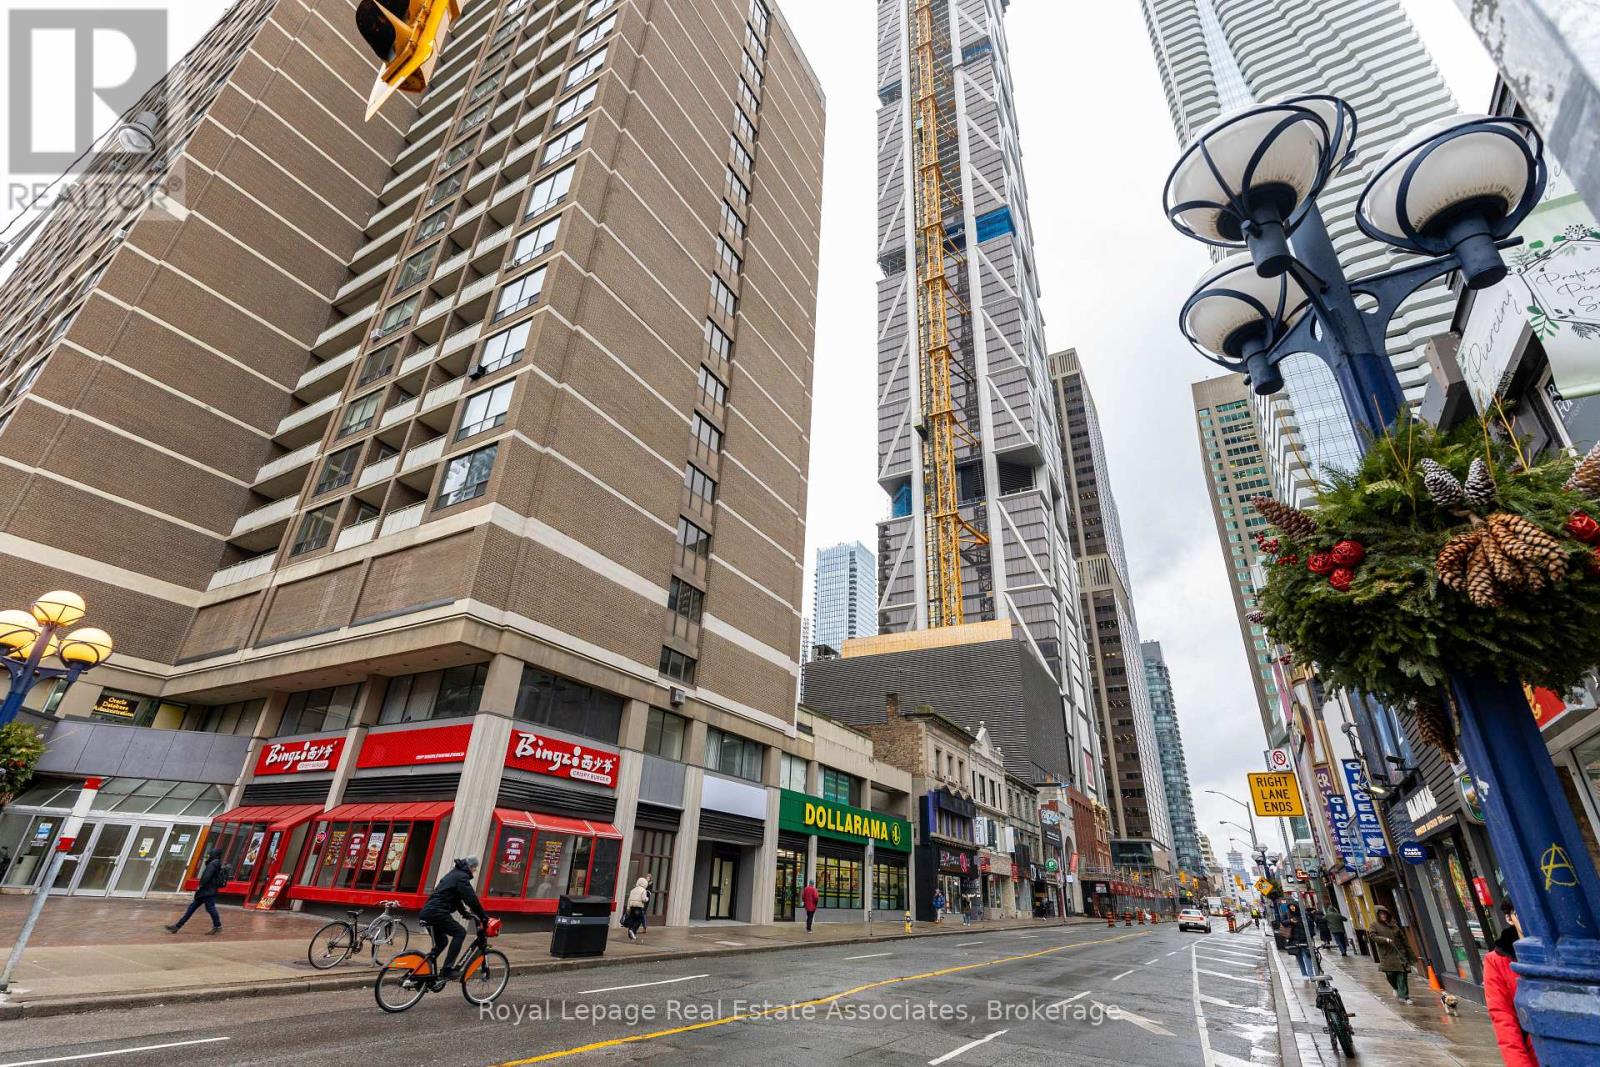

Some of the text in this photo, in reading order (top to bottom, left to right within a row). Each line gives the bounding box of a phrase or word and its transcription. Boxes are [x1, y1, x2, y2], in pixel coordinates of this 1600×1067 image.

[1468, 287, 1522, 387] Piercing
[102, 701, 129, 711] Database
[265, 741, 311, 770] Bingzi
[515, 732, 581, 771] Bingzi
[1256, 776, 1288, 788] RIGHT
[1260, 789, 1290, 800] LANE
[1263, 801, 1294, 812] ENDS
[804, 802, 889, 841] DOLLARAMA
